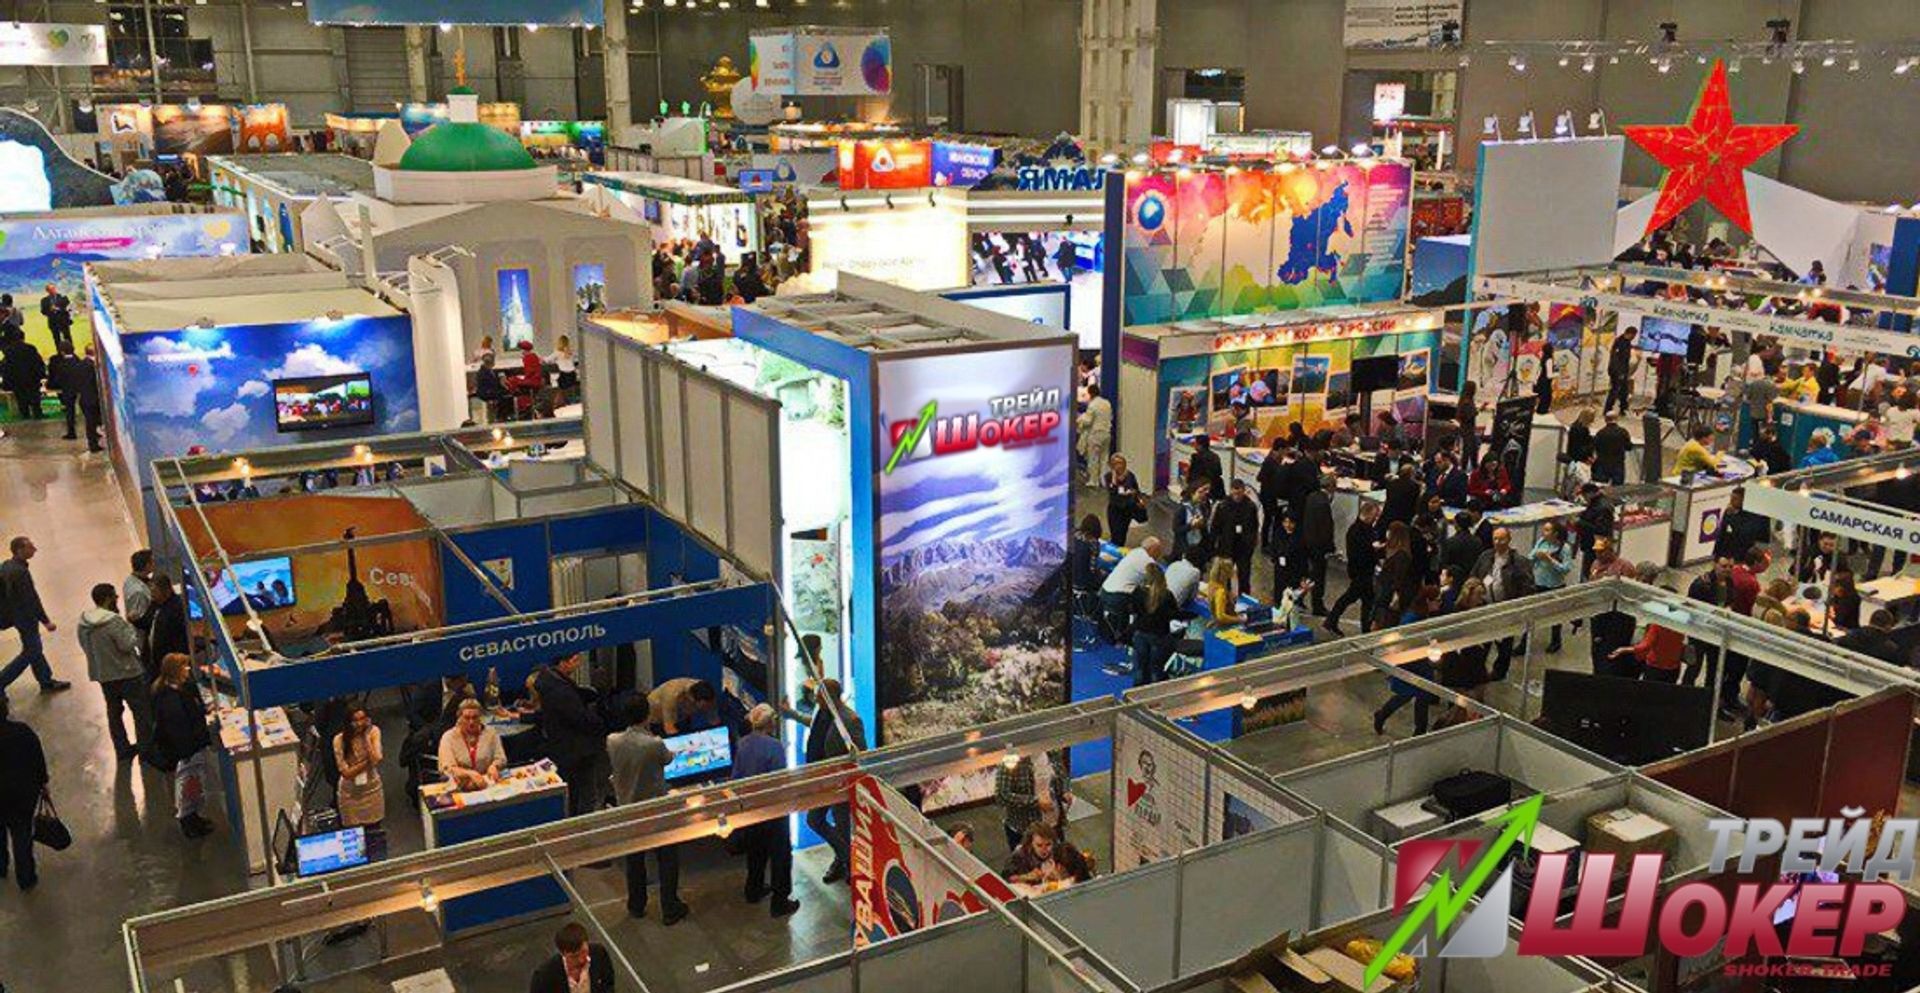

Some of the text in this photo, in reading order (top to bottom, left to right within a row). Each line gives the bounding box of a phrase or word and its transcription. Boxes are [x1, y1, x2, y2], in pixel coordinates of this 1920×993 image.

[1347, 319, 1396, 335] РОСИИ
[1769, 321, 1834, 342] Камчатка
[990, 387, 1059, 417] ТРЕЙД
[1809, 506, 1903, 540] САМАРСКАЯ
[459, 623, 606, 662] СЕВАСТОПОЛЬ
